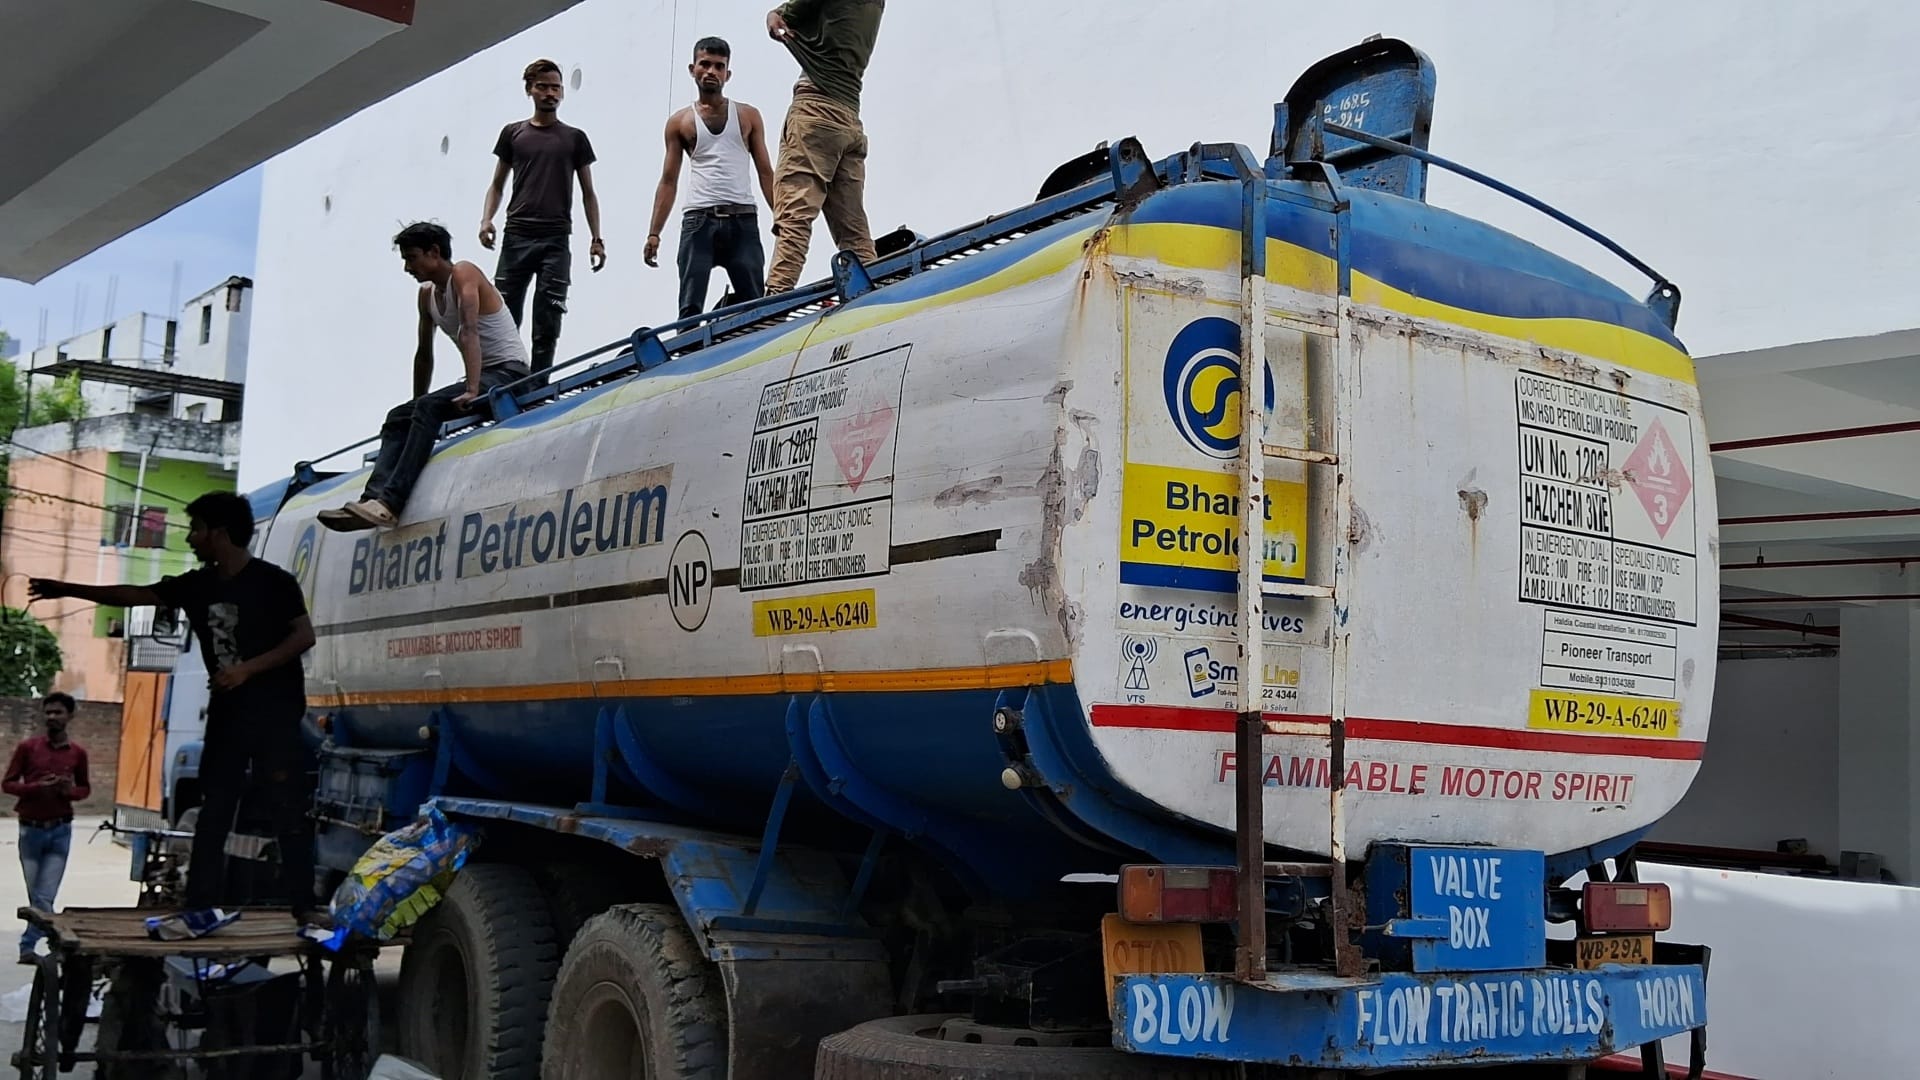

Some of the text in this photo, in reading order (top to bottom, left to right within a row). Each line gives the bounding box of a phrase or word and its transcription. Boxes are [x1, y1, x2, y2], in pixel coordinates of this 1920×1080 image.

[827, 367, 849, 389] NAME
[783, 395, 819, 420] PETROLEUM
[817, 388, 848, 413] PRODUCT
[1520, 376, 1632, 420] CORRECT TECHNICAL NAME
[1521, 400, 1639, 445] MS/HSD PETROLEUM PRODUCT
[751, 427, 814, 474] UN No. 1203
[850, 446, 865, 480] 3
[1524, 433, 1604, 487] UN No. 1203
[746, 474, 789, 517] HAZCHEM
[1166, 481, 1273, 522] Bhart
[1525, 481, 1583, 529] HAZCHEM
[1653, 494, 1669, 526] 3
[752, 520, 790, 543] EMERGENCY
[810, 507, 873, 534] SPECIALIST ADVICE
[348, 484, 668, 595] Bharat Petroleum
[809, 538, 820, 557] USE
[820, 534, 837, 555] FOAM
[841, 533, 854, 552] DCP
[1525, 530, 1534, 550] IN
[1537, 532, 1588, 558] EMERGENCY
[790, 561, 804, 581] 102
[808, 554, 866, 579] FIRE EXTINGUISHERS
[1555, 558, 1569, 579] 100
[1597, 565, 1609, 585] 101
[1614, 546, 1680, 576] SPECIALIST ADVICE
[673, 560, 708, 608] NP
[1615, 568, 1628, 589] USE
[1629, 570, 1646, 591] FOAM
[1651, 575, 1663, 594] DCP
[1592, 588, 1609, 608] 102
[1615, 591, 1676, 619] FIRE EXTINGUISHERS
[768, 601, 869, 632] WB-29-A-6240
[1261, 610, 1304, 634] ives
[1553, 616, 1573, 627] Haldia
[1574, 620, 1597, 629] Coastal
[387, 625, 522, 659] FLAMMABLE MOTOR SPIRIT
[1561, 643, 1652, 666] Pioneer Transport
[1126, 694, 1146, 704] VTS
[1275, 690, 1297, 699] 4344
[1544, 698, 1668, 731] WB-29-A-6240
[1218, 752, 1635, 802] FAMMABLE MOTOR SPIRIT
[1430, 855, 1502, 901] VALVE
[1448, 905, 1491, 950] BOX
[1132, 983, 1235, 1045] BLOW
[1357, 985, 1431, 1046] FLOW
[1436, 979, 1524, 1043] TRAFIC
[1635, 974, 1697, 1030] HORN
